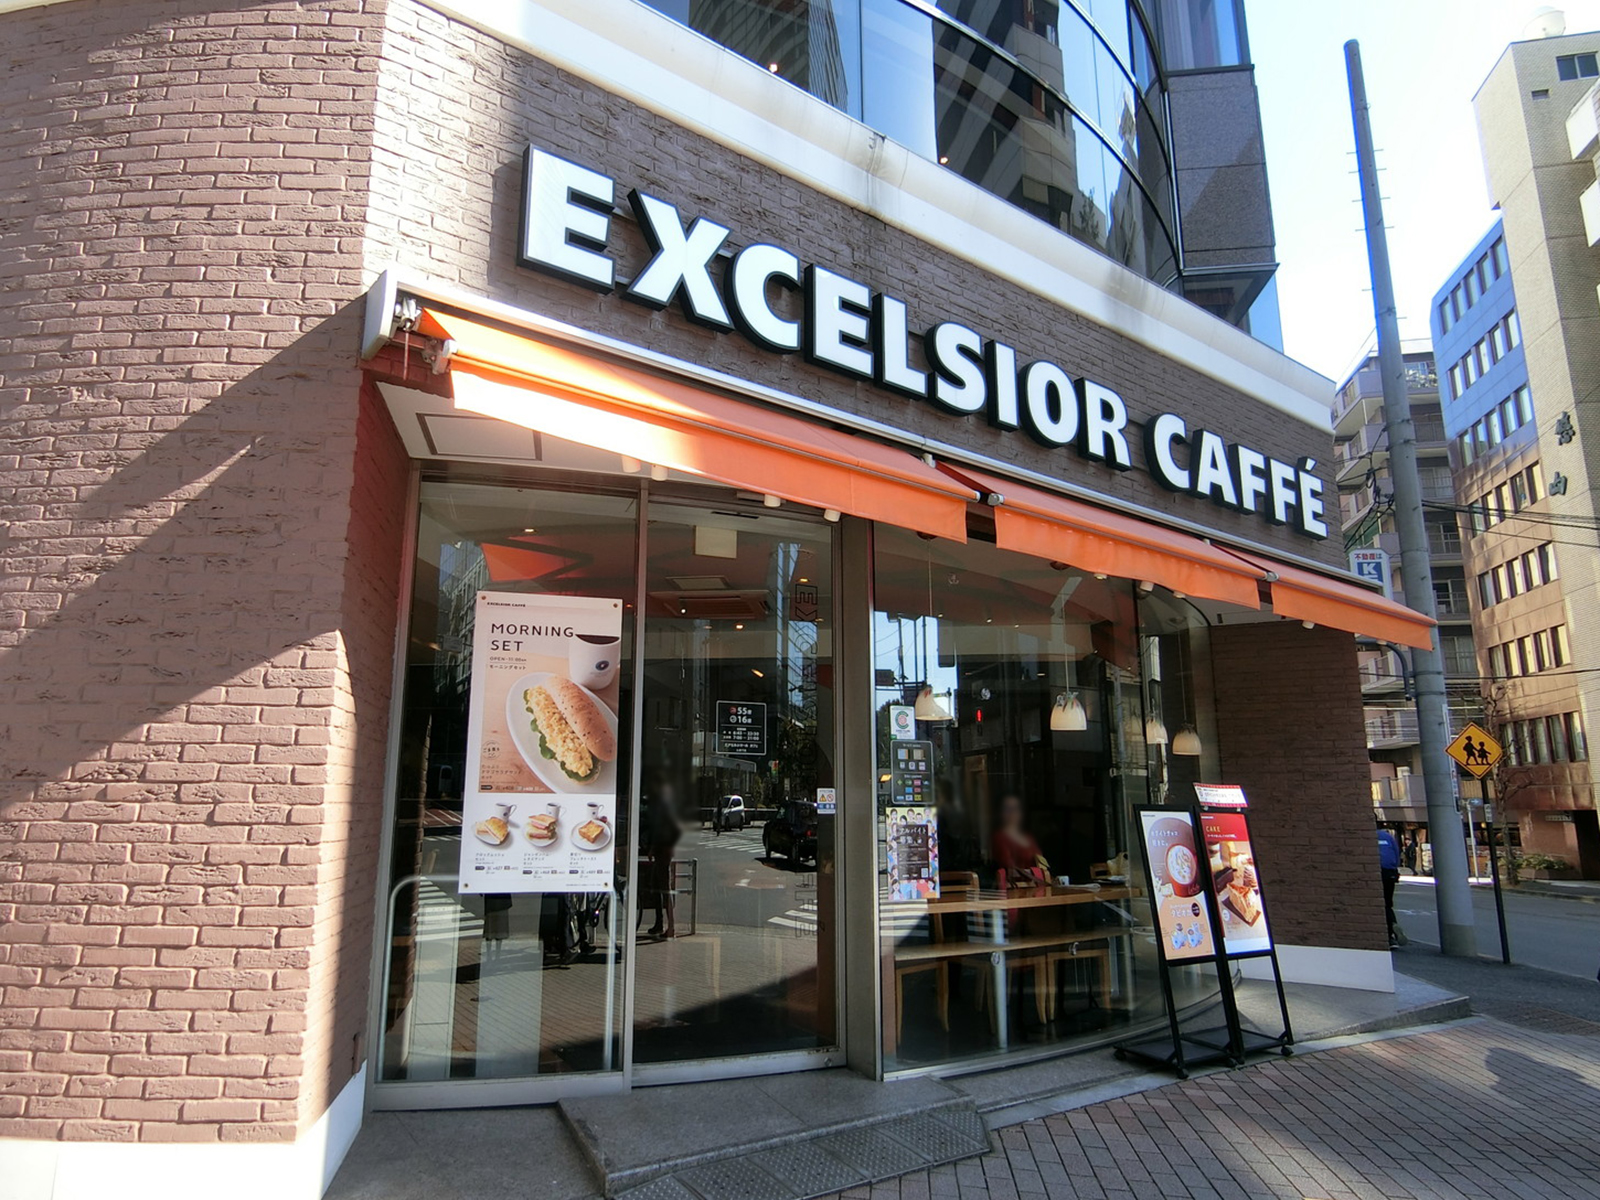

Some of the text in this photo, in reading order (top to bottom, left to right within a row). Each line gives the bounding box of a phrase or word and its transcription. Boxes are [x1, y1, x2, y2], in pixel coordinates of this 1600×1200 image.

[517, 143, 1329, 540] EXCELSIOR CAFFÉ
[491, 623, 575, 637] MORNING
[490, 640, 524, 652] SET
